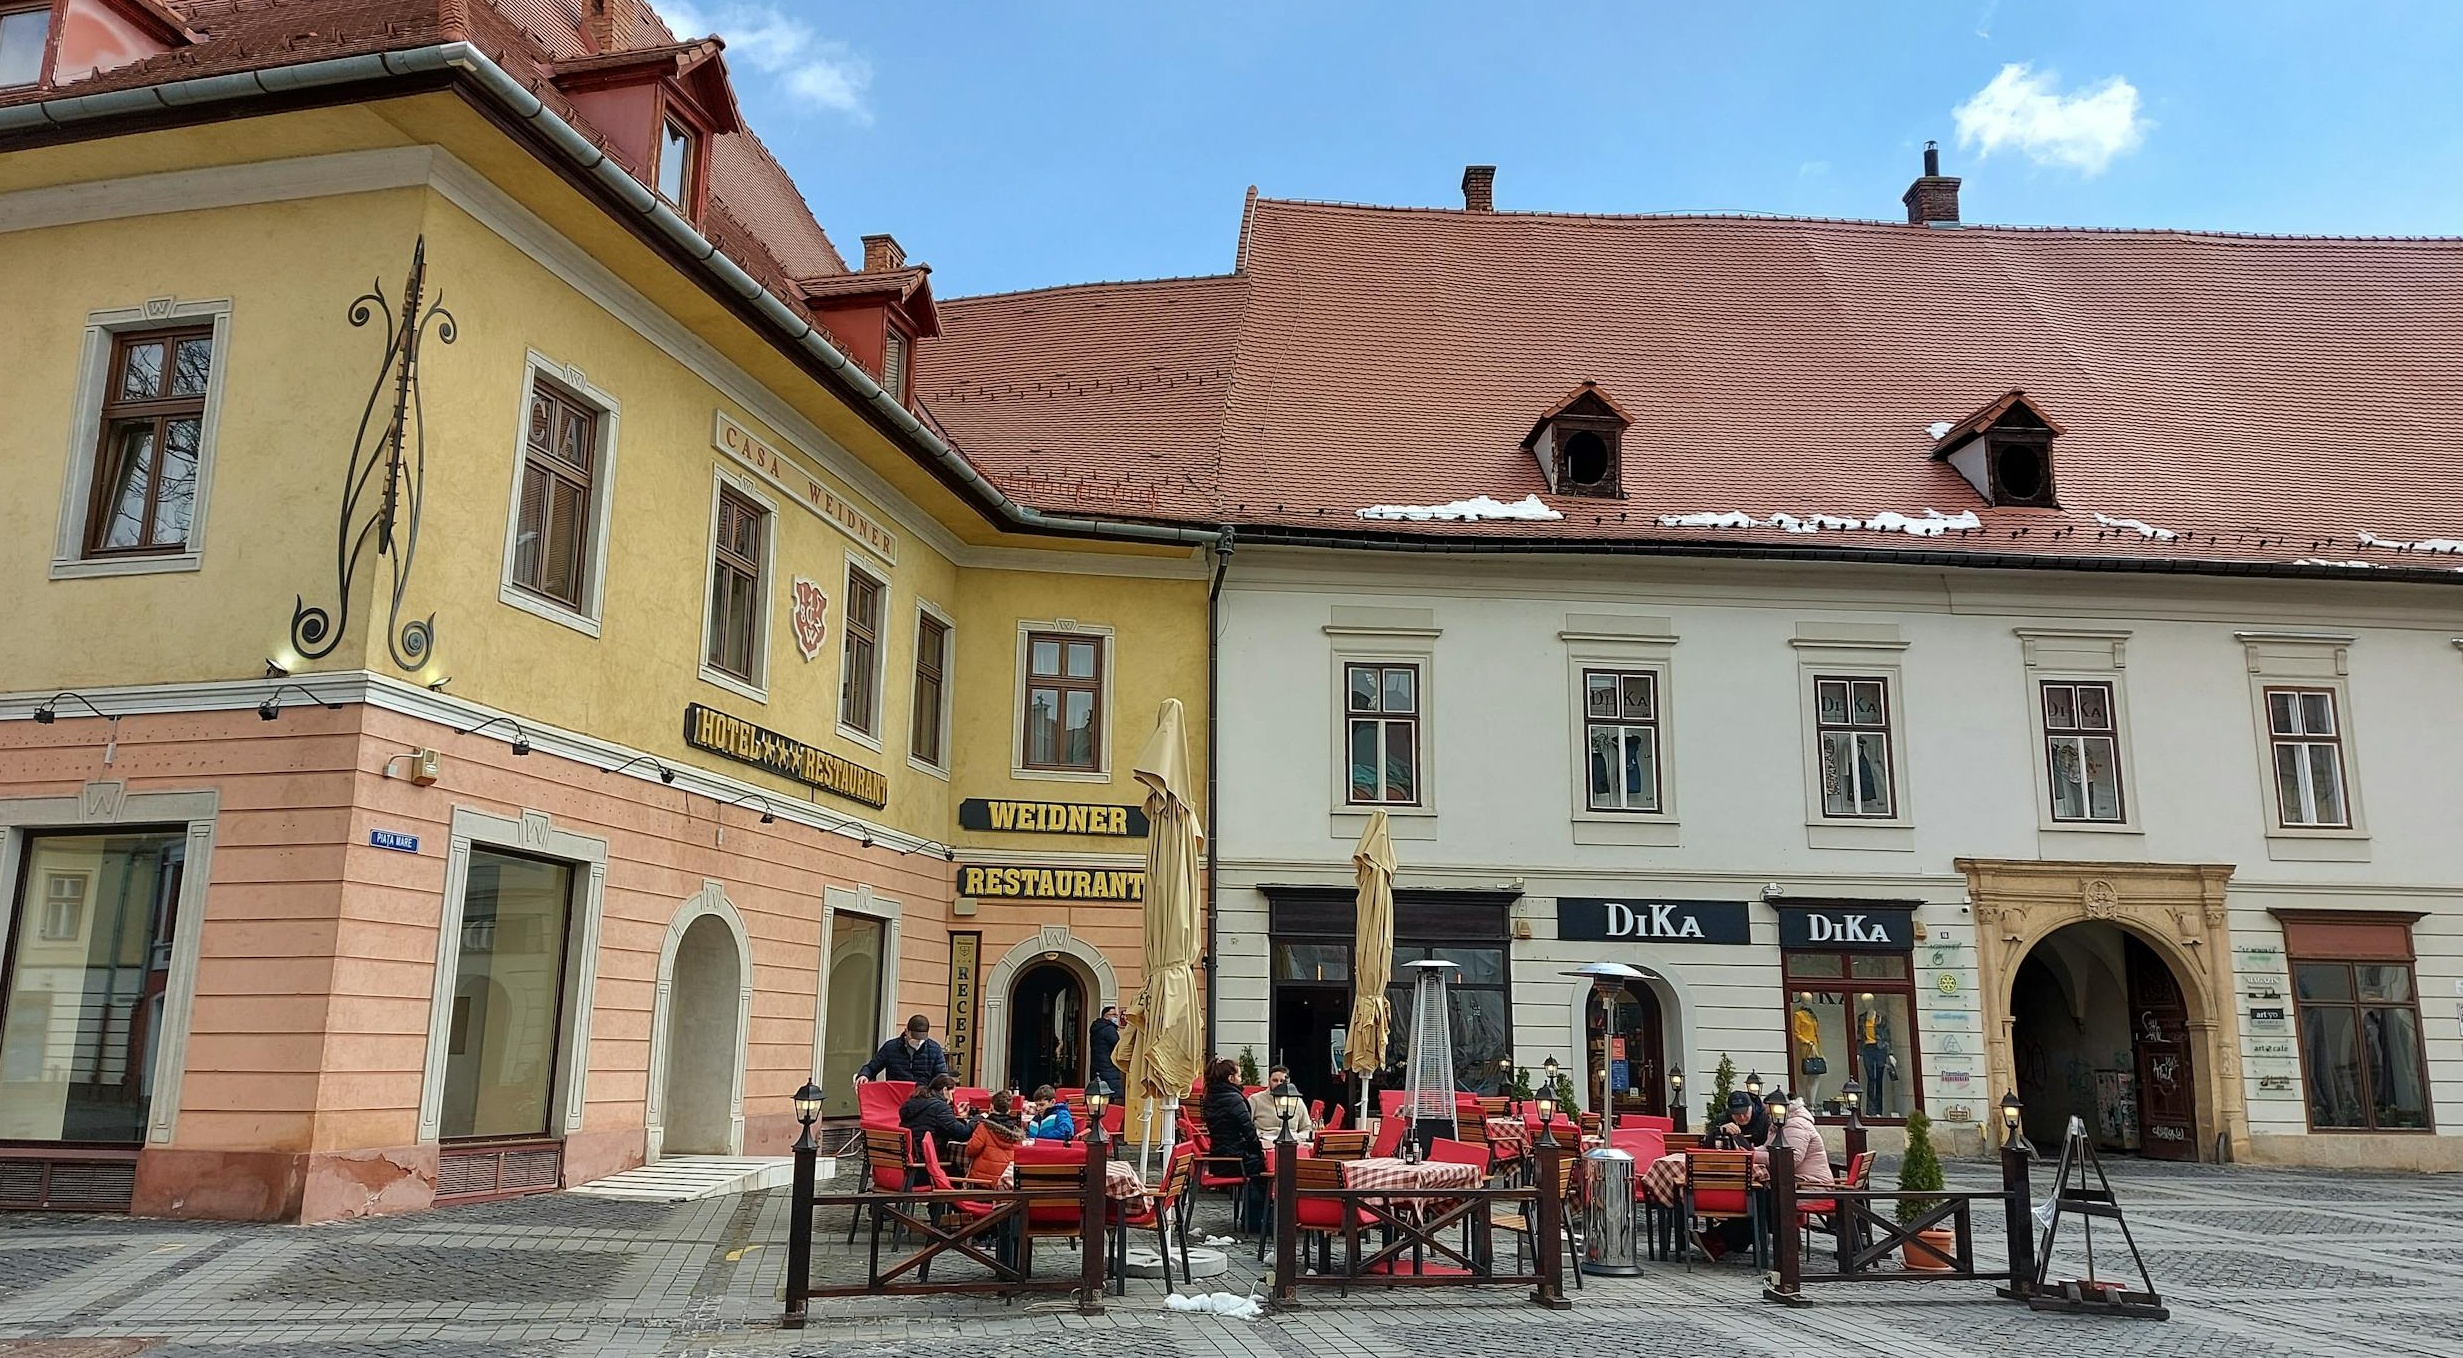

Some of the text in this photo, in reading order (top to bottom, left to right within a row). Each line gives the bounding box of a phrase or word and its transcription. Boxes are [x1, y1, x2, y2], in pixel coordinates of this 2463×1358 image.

[726, 427, 892, 554] CASA WEIDNER
[696, 707, 888, 807] HOTEL RESTAURANT
[988, 801, 1128, 835] WEIDNER
[395, 835, 413, 849] MARE
[965, 867, 1145, 900] RESTAURANT
